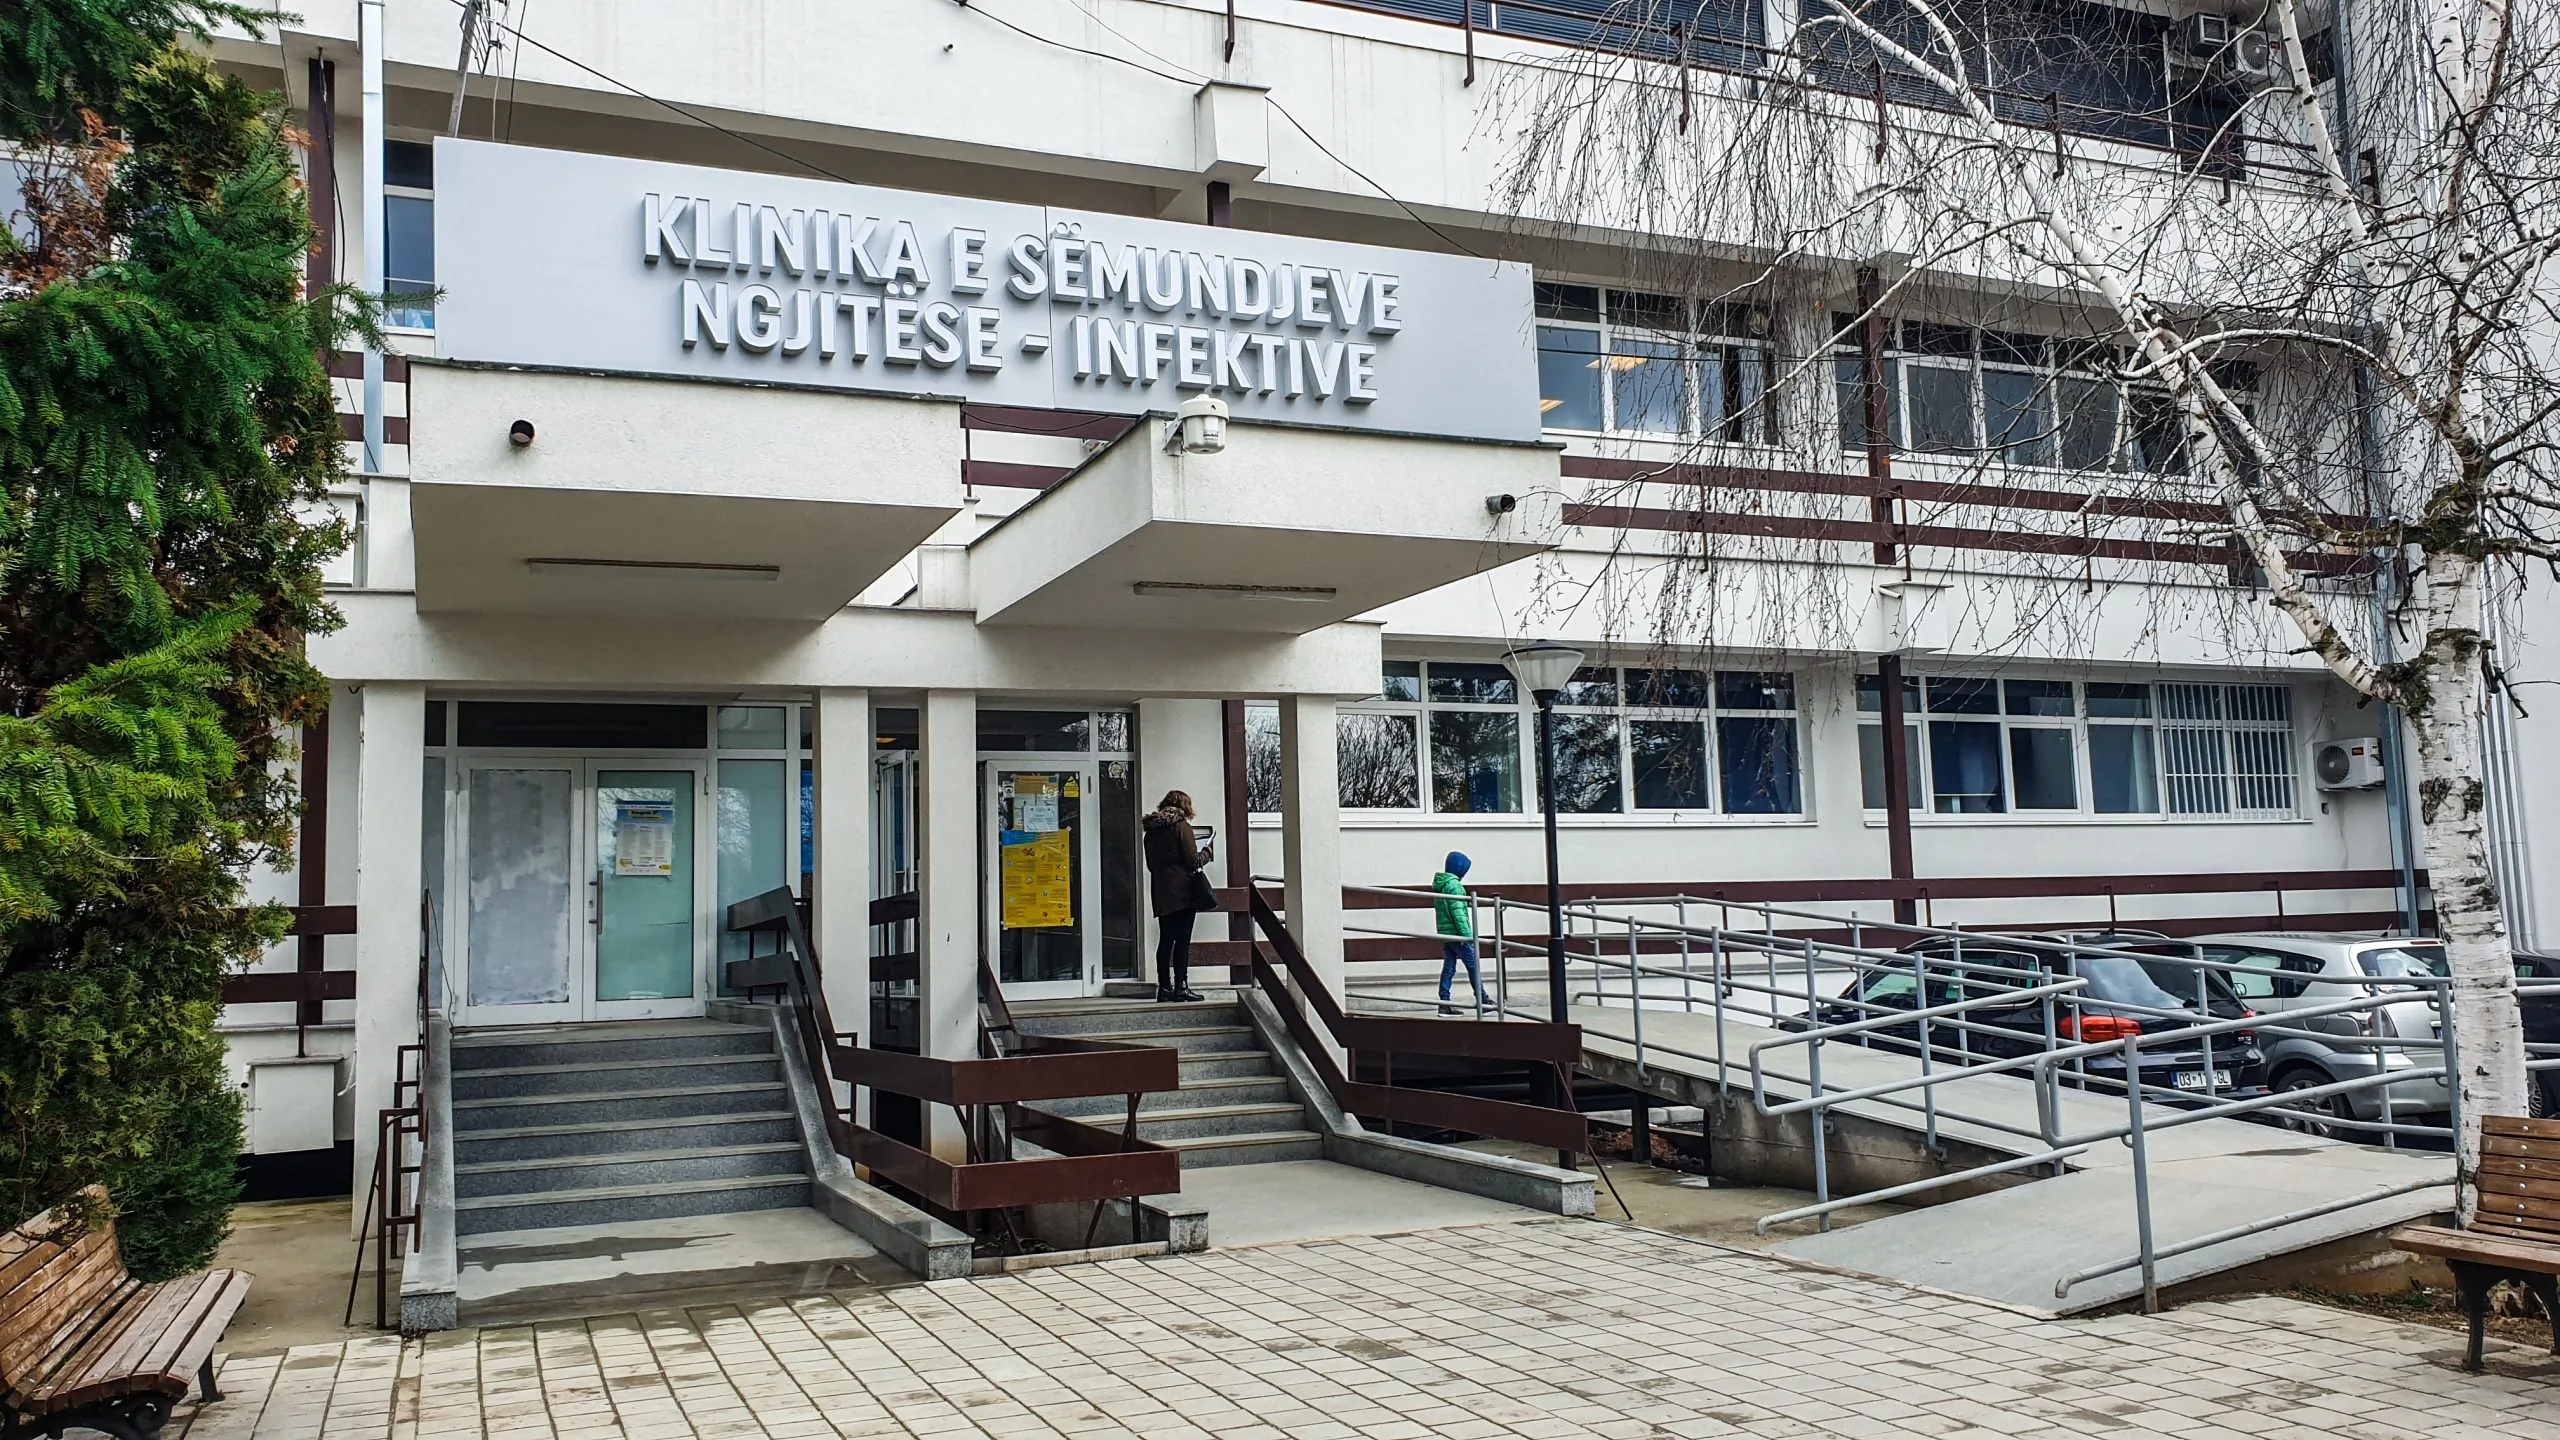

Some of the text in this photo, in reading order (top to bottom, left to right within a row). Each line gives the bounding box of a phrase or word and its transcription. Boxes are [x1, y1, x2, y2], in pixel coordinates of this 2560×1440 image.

[644, 192, 1402, 335] KLINIKA E SËMUNDJEVE
[681, 278, 1004, 373] NGJITËSE
[1071, 314, 1379, 404] INFEKTIVE
